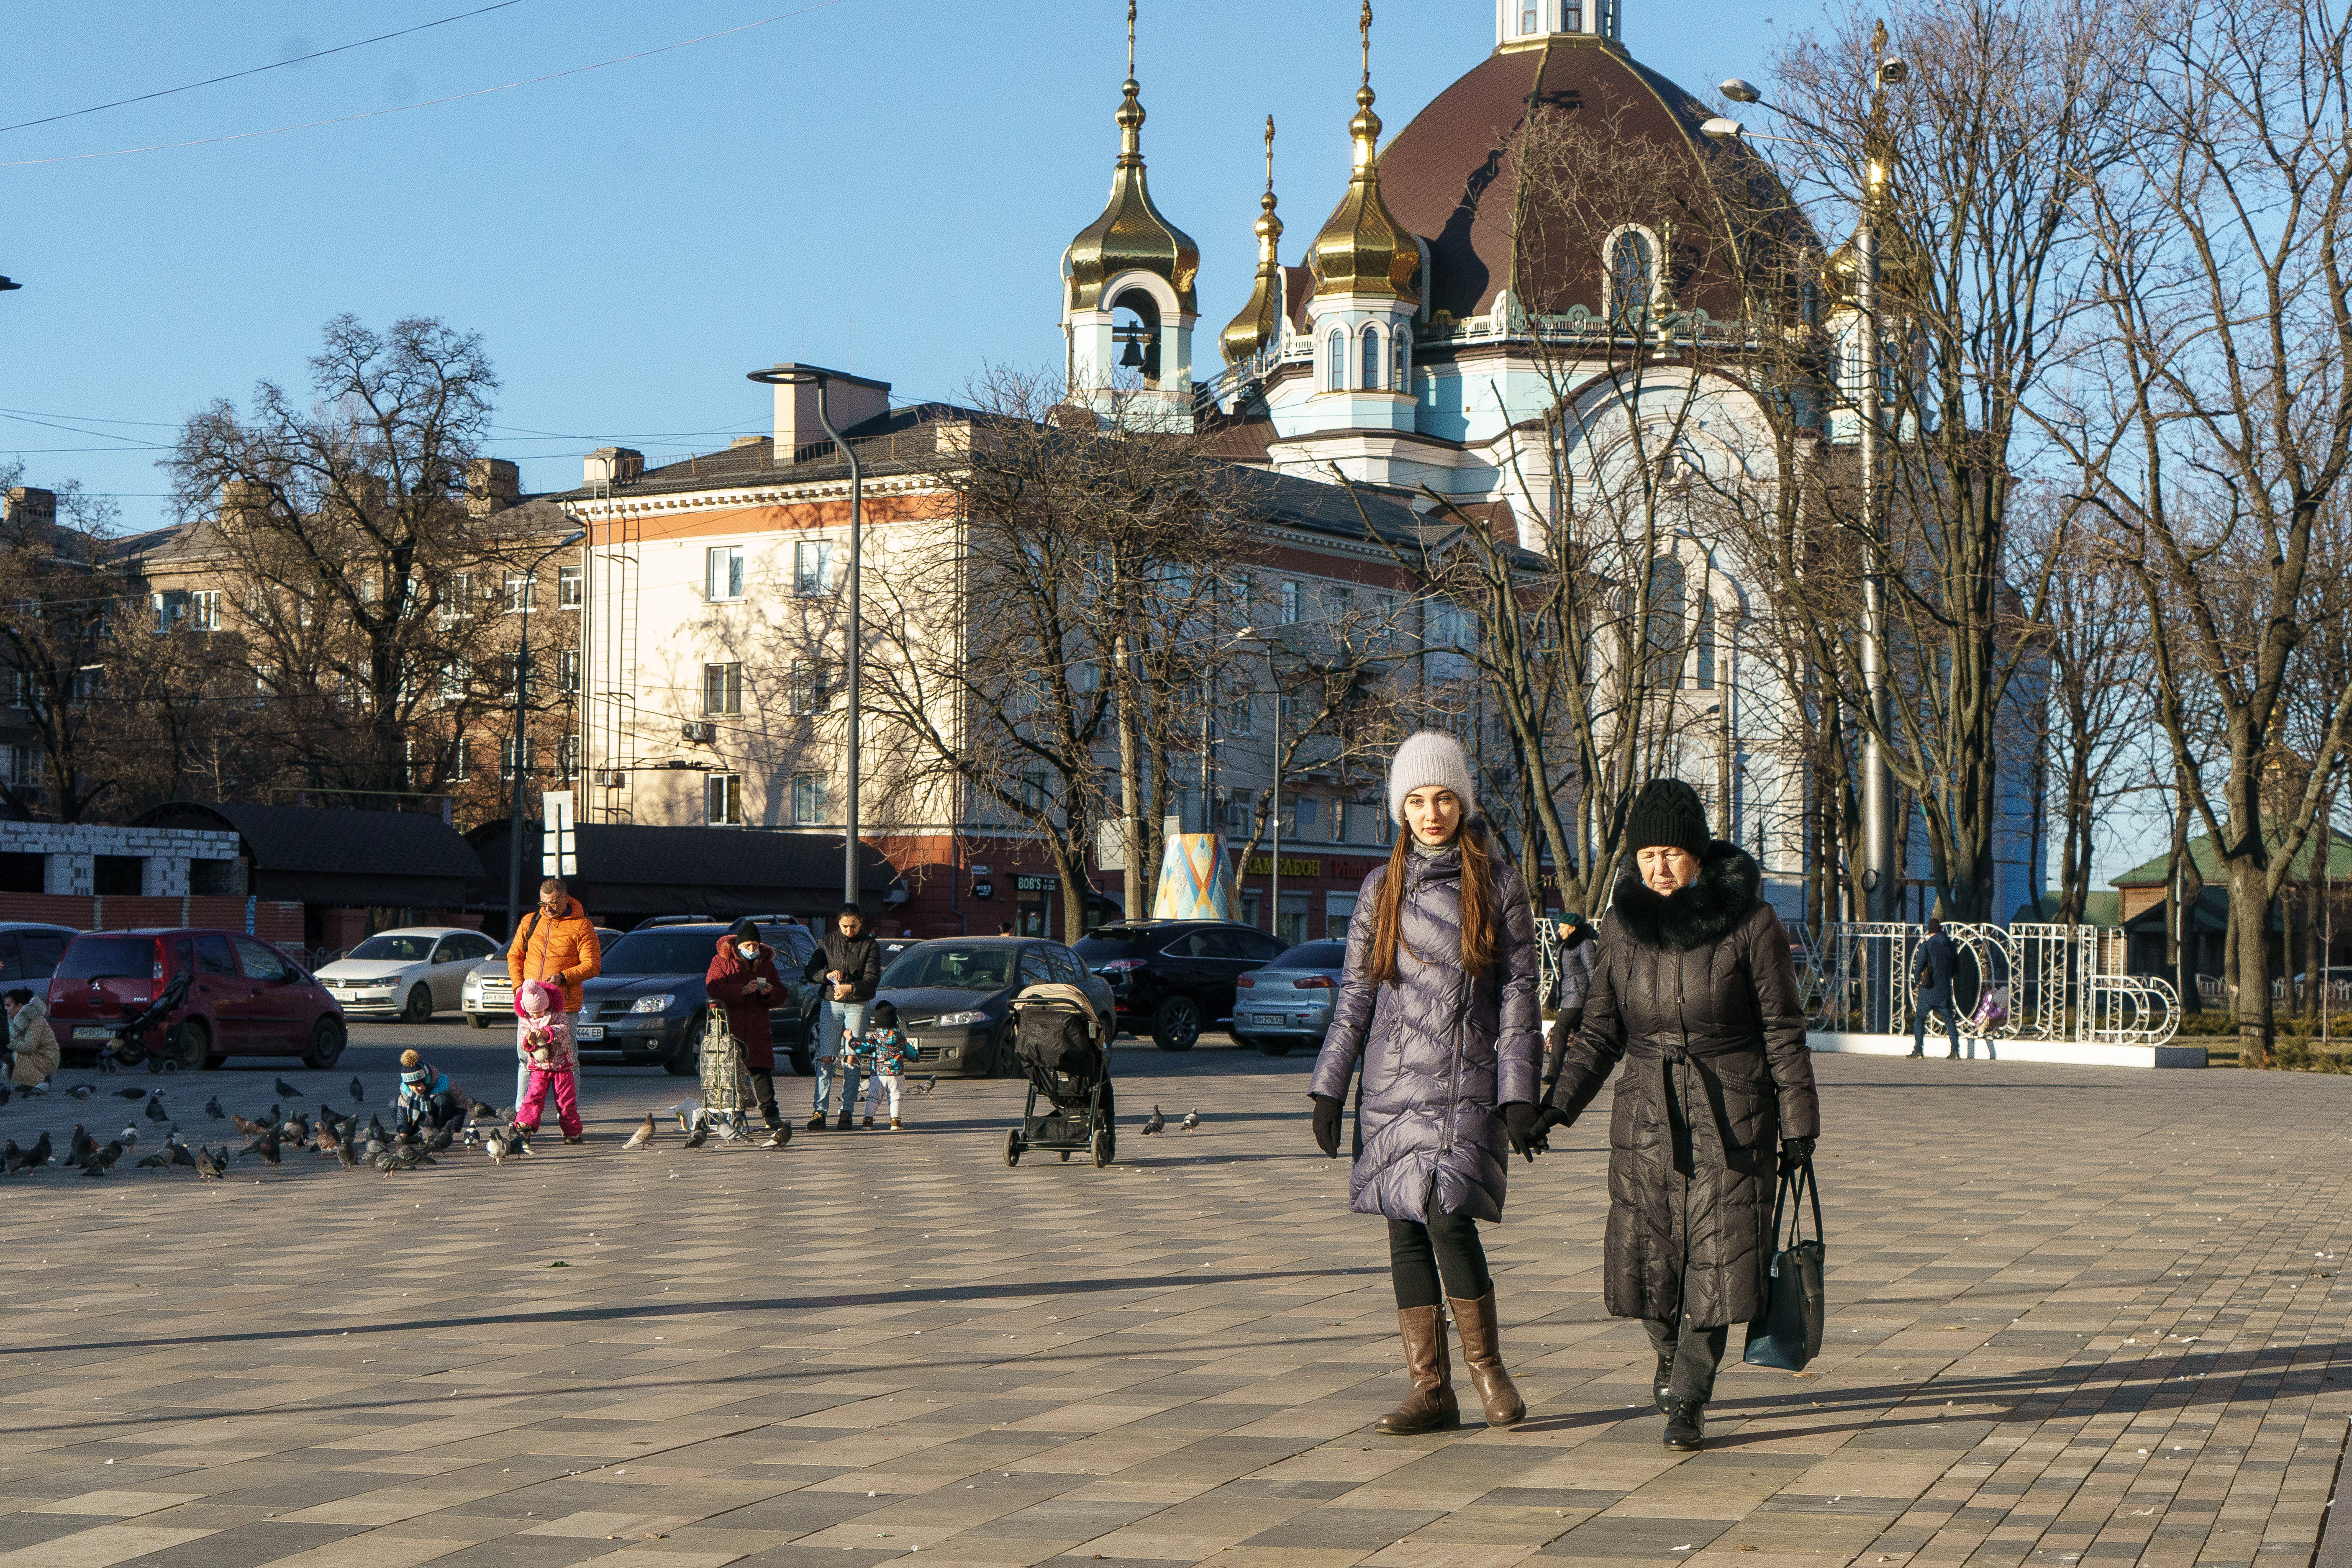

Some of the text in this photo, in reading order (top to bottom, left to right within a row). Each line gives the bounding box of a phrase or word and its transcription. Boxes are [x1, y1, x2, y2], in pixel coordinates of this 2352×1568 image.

[1018, 877, 1041, 890] BOB'S
[577, 1028, 602, 1037] 444 EB
